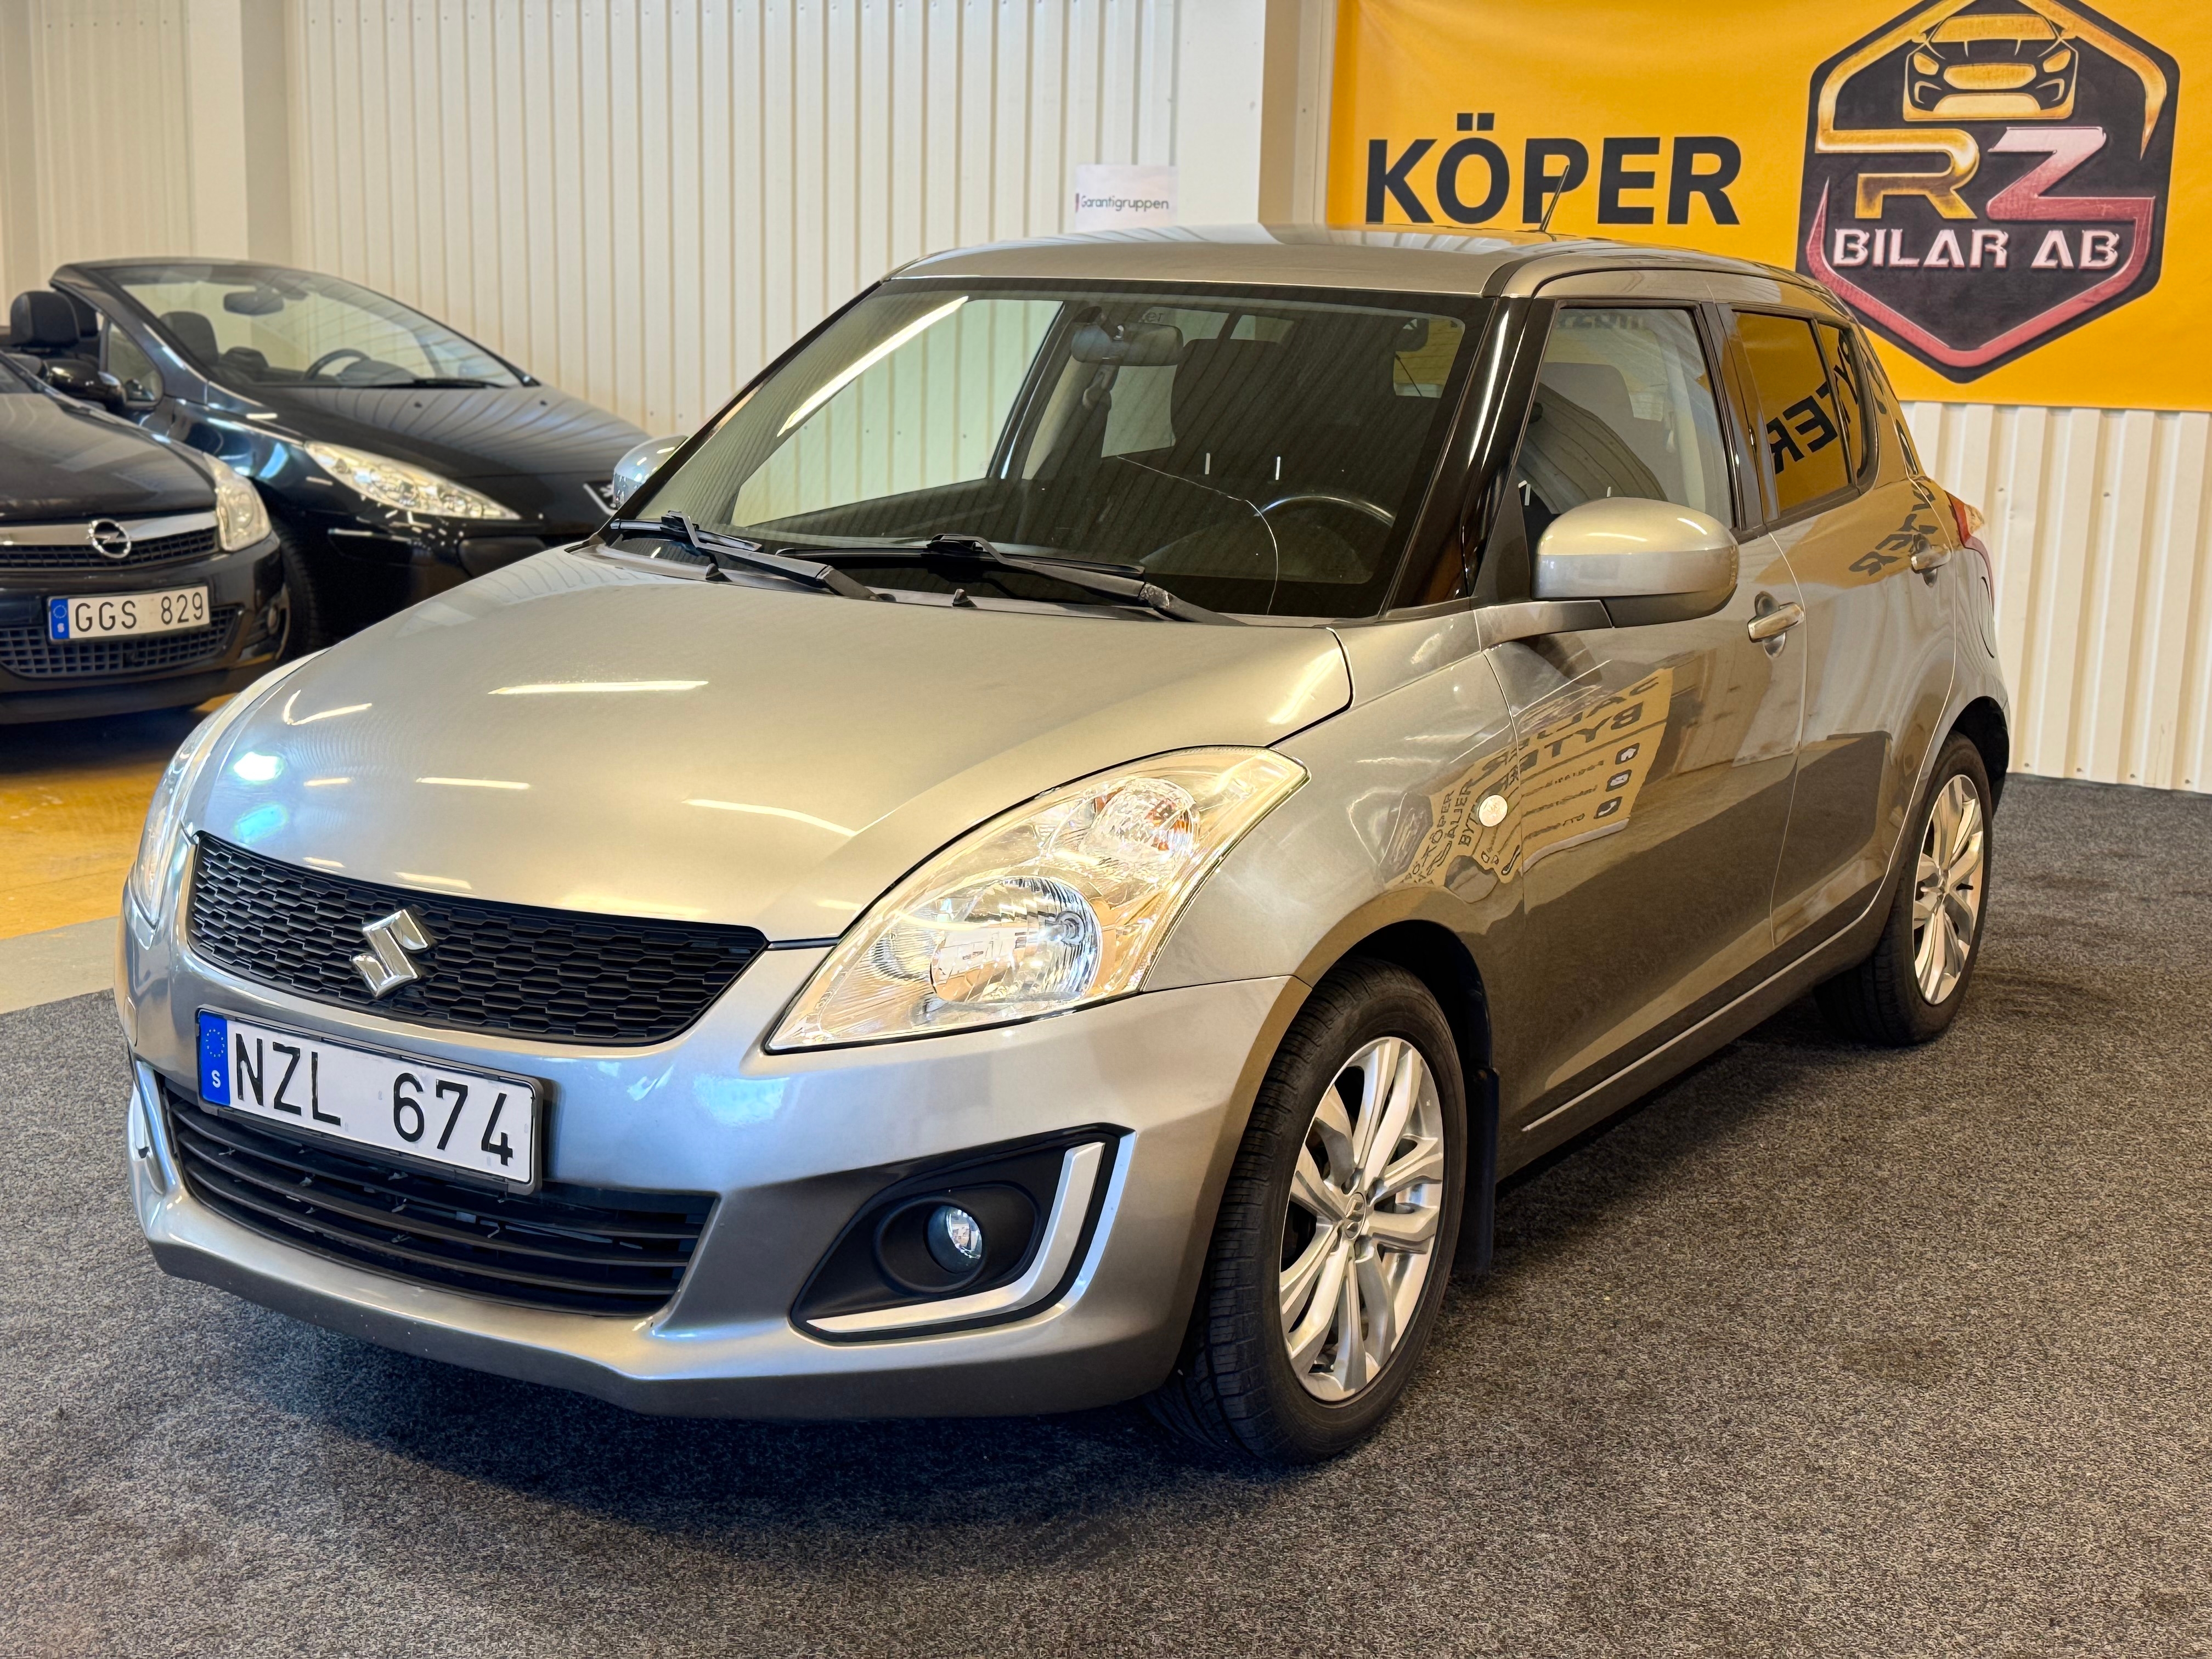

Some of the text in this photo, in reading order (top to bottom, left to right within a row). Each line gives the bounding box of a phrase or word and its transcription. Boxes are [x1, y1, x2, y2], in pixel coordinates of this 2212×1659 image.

[1365, 112, 1742, 225] KÖPER
[1815, 126, 2155, 221] RZ
[1081, 195, 1169, 212] Garantigruppen
[1832, 228, 2120, 269] BILAR AB
[75, 592, 204, 632] GGS 829
[211, 1069, 221, 1088] S
[235, 1033, 514, 1166] NZL 674
